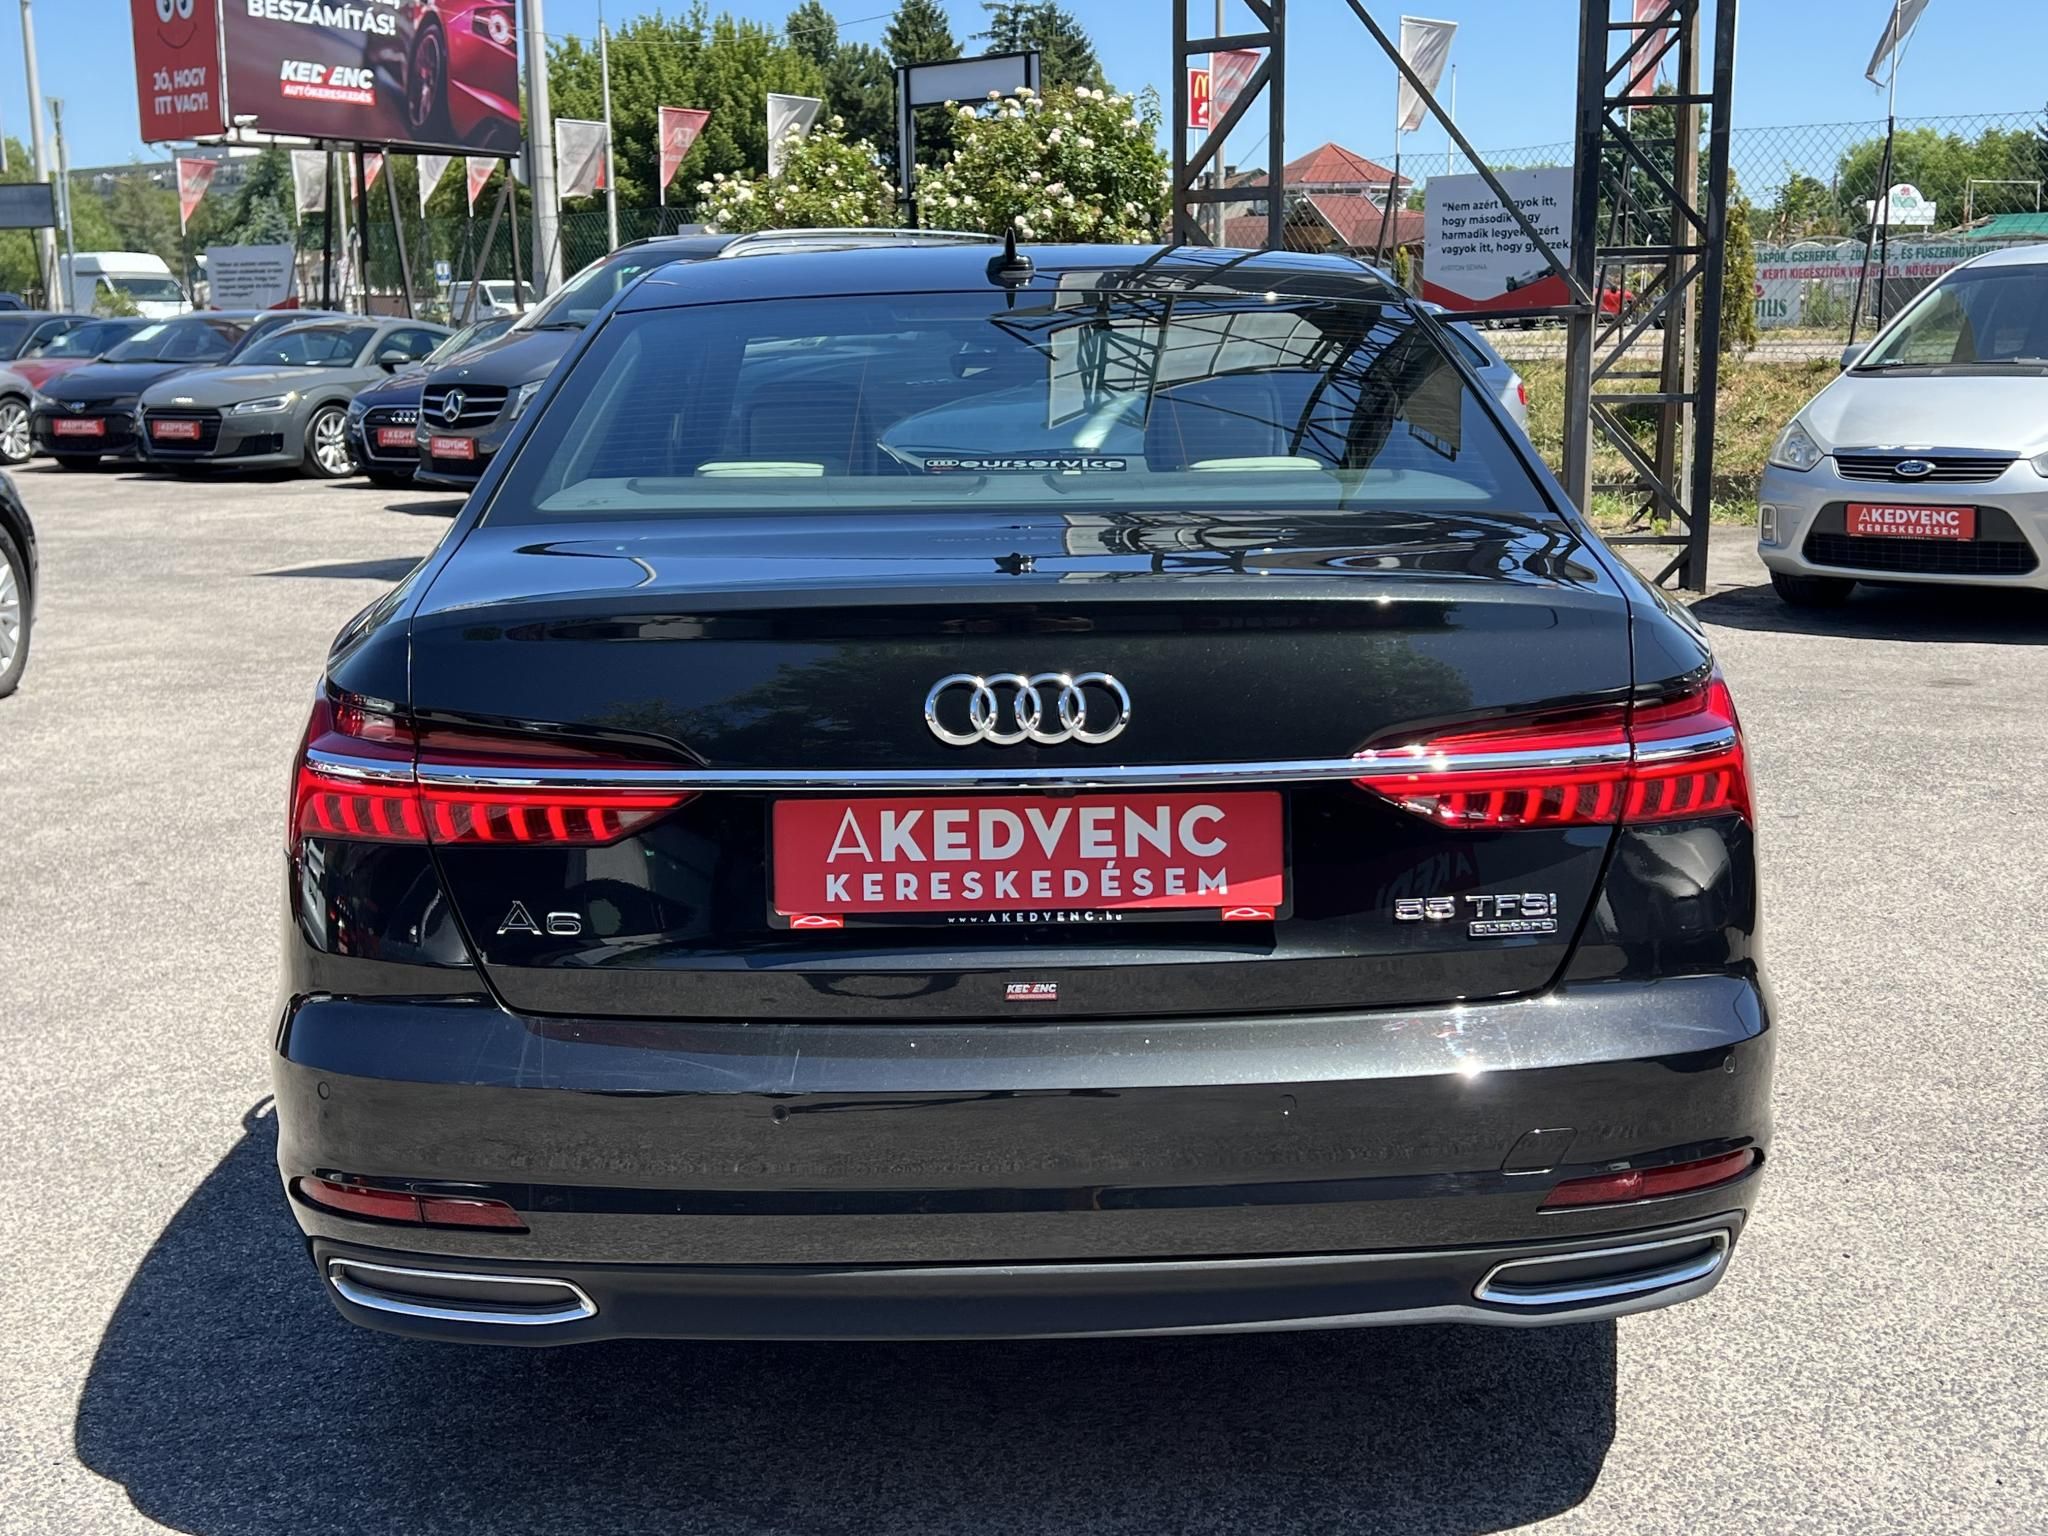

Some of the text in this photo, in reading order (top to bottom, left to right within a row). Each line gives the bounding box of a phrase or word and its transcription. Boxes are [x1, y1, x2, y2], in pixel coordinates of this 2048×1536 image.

[247, 0, 396, 36] BESZÁMÍTÁS!
[174, 67, 207, 87] HOGY
[154, 93, 209, 115] ITT VAGY!
[1472, 202, 1499, 211] azért
[1541, 196, 1557, 207] itt,
[1442, 217, 1467, 227] hogy
[1469, 214, 1512, 224] második
[1442, 229, 1489, 240] harmadik
[1441, 244, 1477, 256] vagyok
[1479, 243, 1495, 254] itt,
[1496, 242, 1523, 253] hogy
[1859, 507, 1960, 526] AKEDVENC
[1858, 523, 1960, 535] KERESKEDÉSEM
[826, 804, 1228, 863] AKEDVENC
[826, 861, 1229, 902] KERESKEDÉSEM
[1395, 893, 1557, 920] 55 TFSI
[496, 900, 581, 935] A6
[947, 911, 1122, 923] www.AKEDVENC.hu
[1474, 922, 1555, 933] quattro
